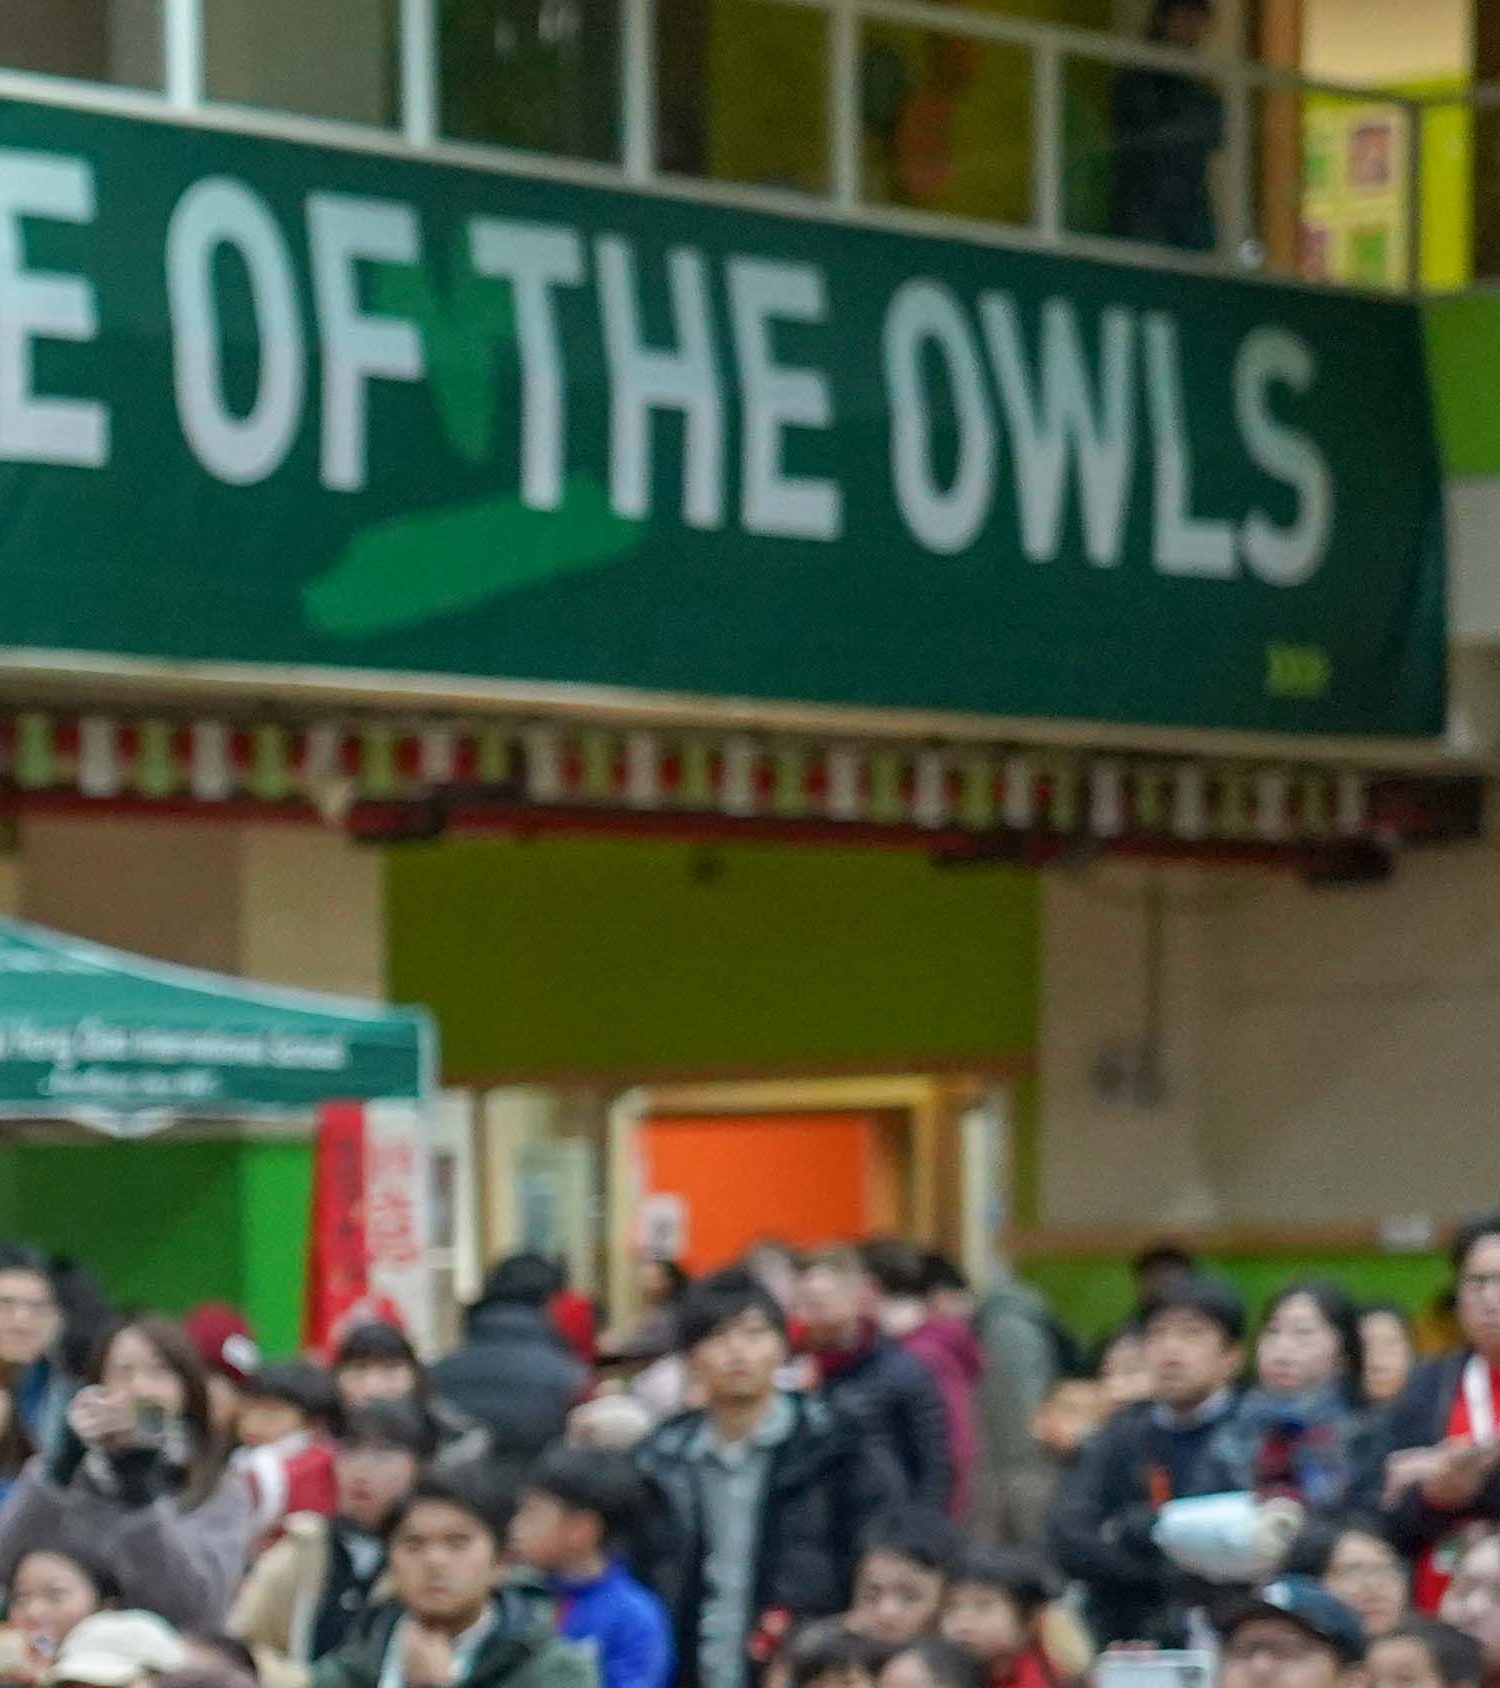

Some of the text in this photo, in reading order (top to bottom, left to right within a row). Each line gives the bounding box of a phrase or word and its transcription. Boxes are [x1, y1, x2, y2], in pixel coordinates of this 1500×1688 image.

[166, 176, 426, 492] OF
[470, 216, 843, 541] THE
[883, 278, 1336, 587] OWLS
